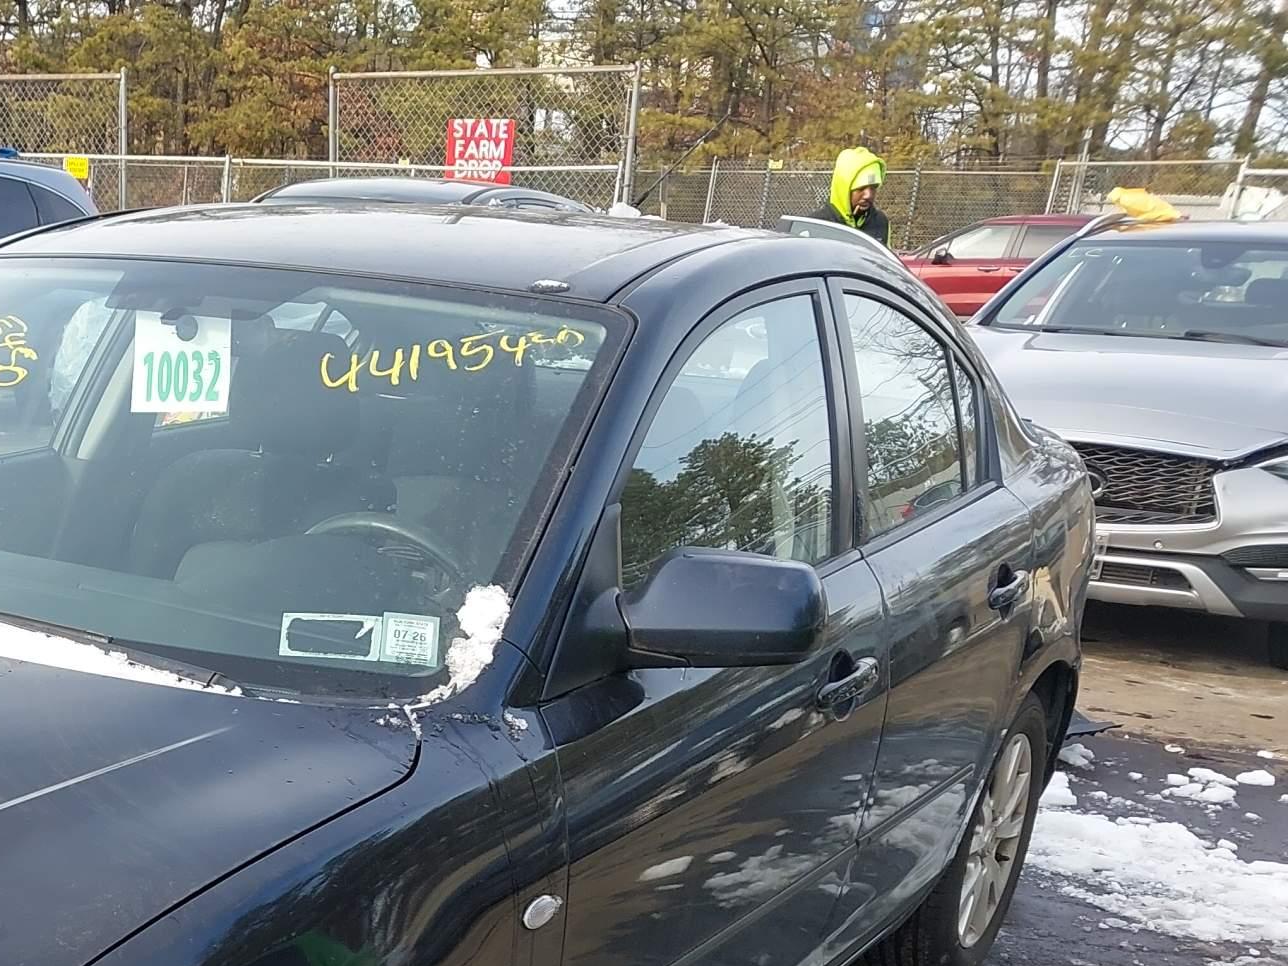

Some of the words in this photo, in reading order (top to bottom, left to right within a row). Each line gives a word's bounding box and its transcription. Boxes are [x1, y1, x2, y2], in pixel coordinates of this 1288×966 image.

[453, 118, 510, 138] STATE
[455, 139, 505, 159] FARM
[455, 159, 502, 179] DROP
[144, 350, 221, 402] 10032
